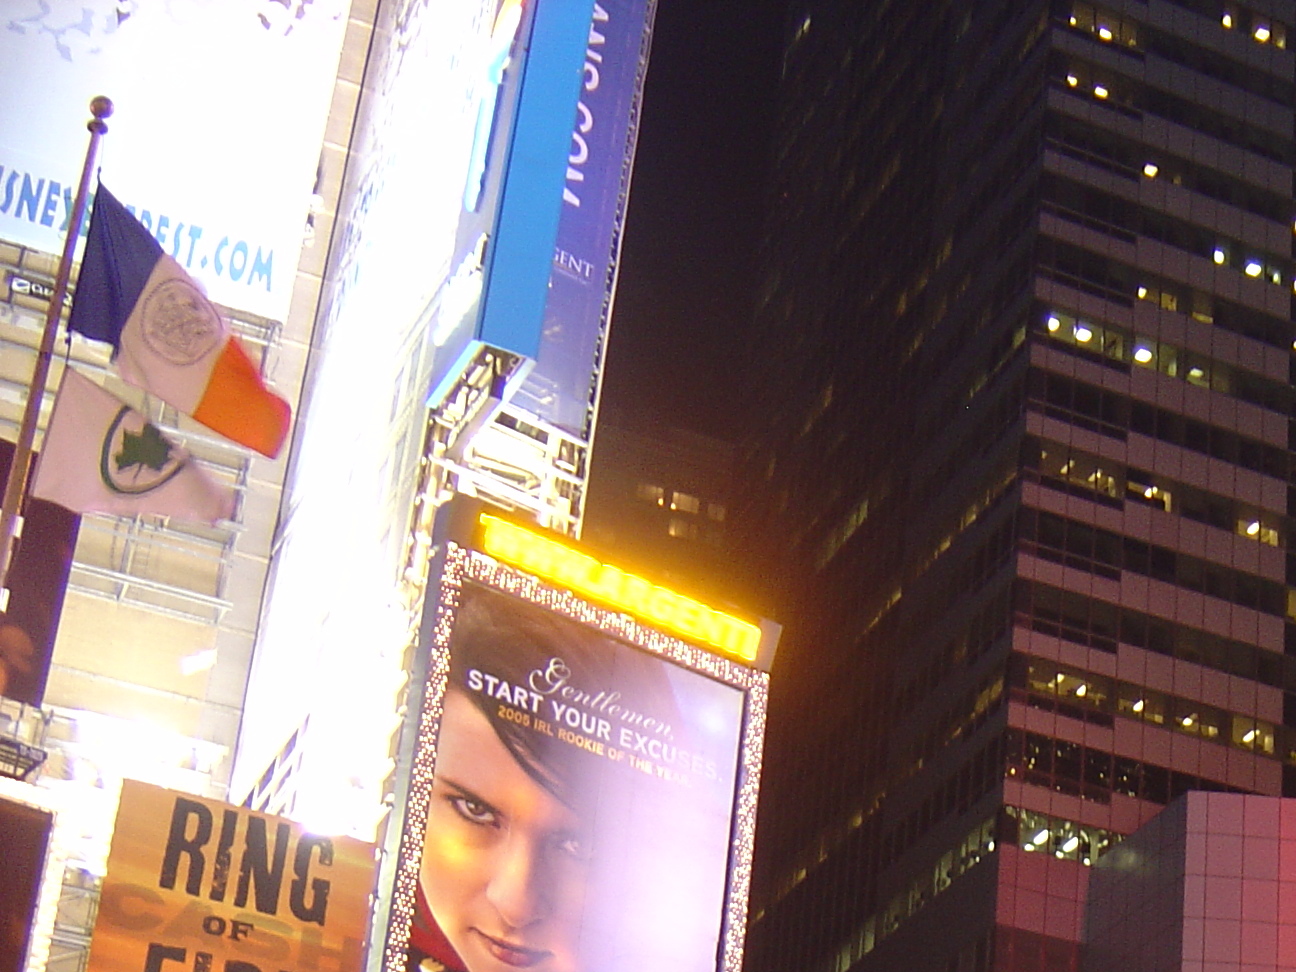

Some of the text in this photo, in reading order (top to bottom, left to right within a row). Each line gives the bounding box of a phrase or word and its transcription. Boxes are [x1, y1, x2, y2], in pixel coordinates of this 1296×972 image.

[467, 669, 723, 783] START YOUR EXCUSES.
[498, 705, 530, 728] 2005
[558, 728, 604, 756] ROOKIE
[608, 747, 625, 762] OF
[628, 754, 652, 774] THE
[159, 797, 334, 927] RING
[202, 915, 255, 942] OF
